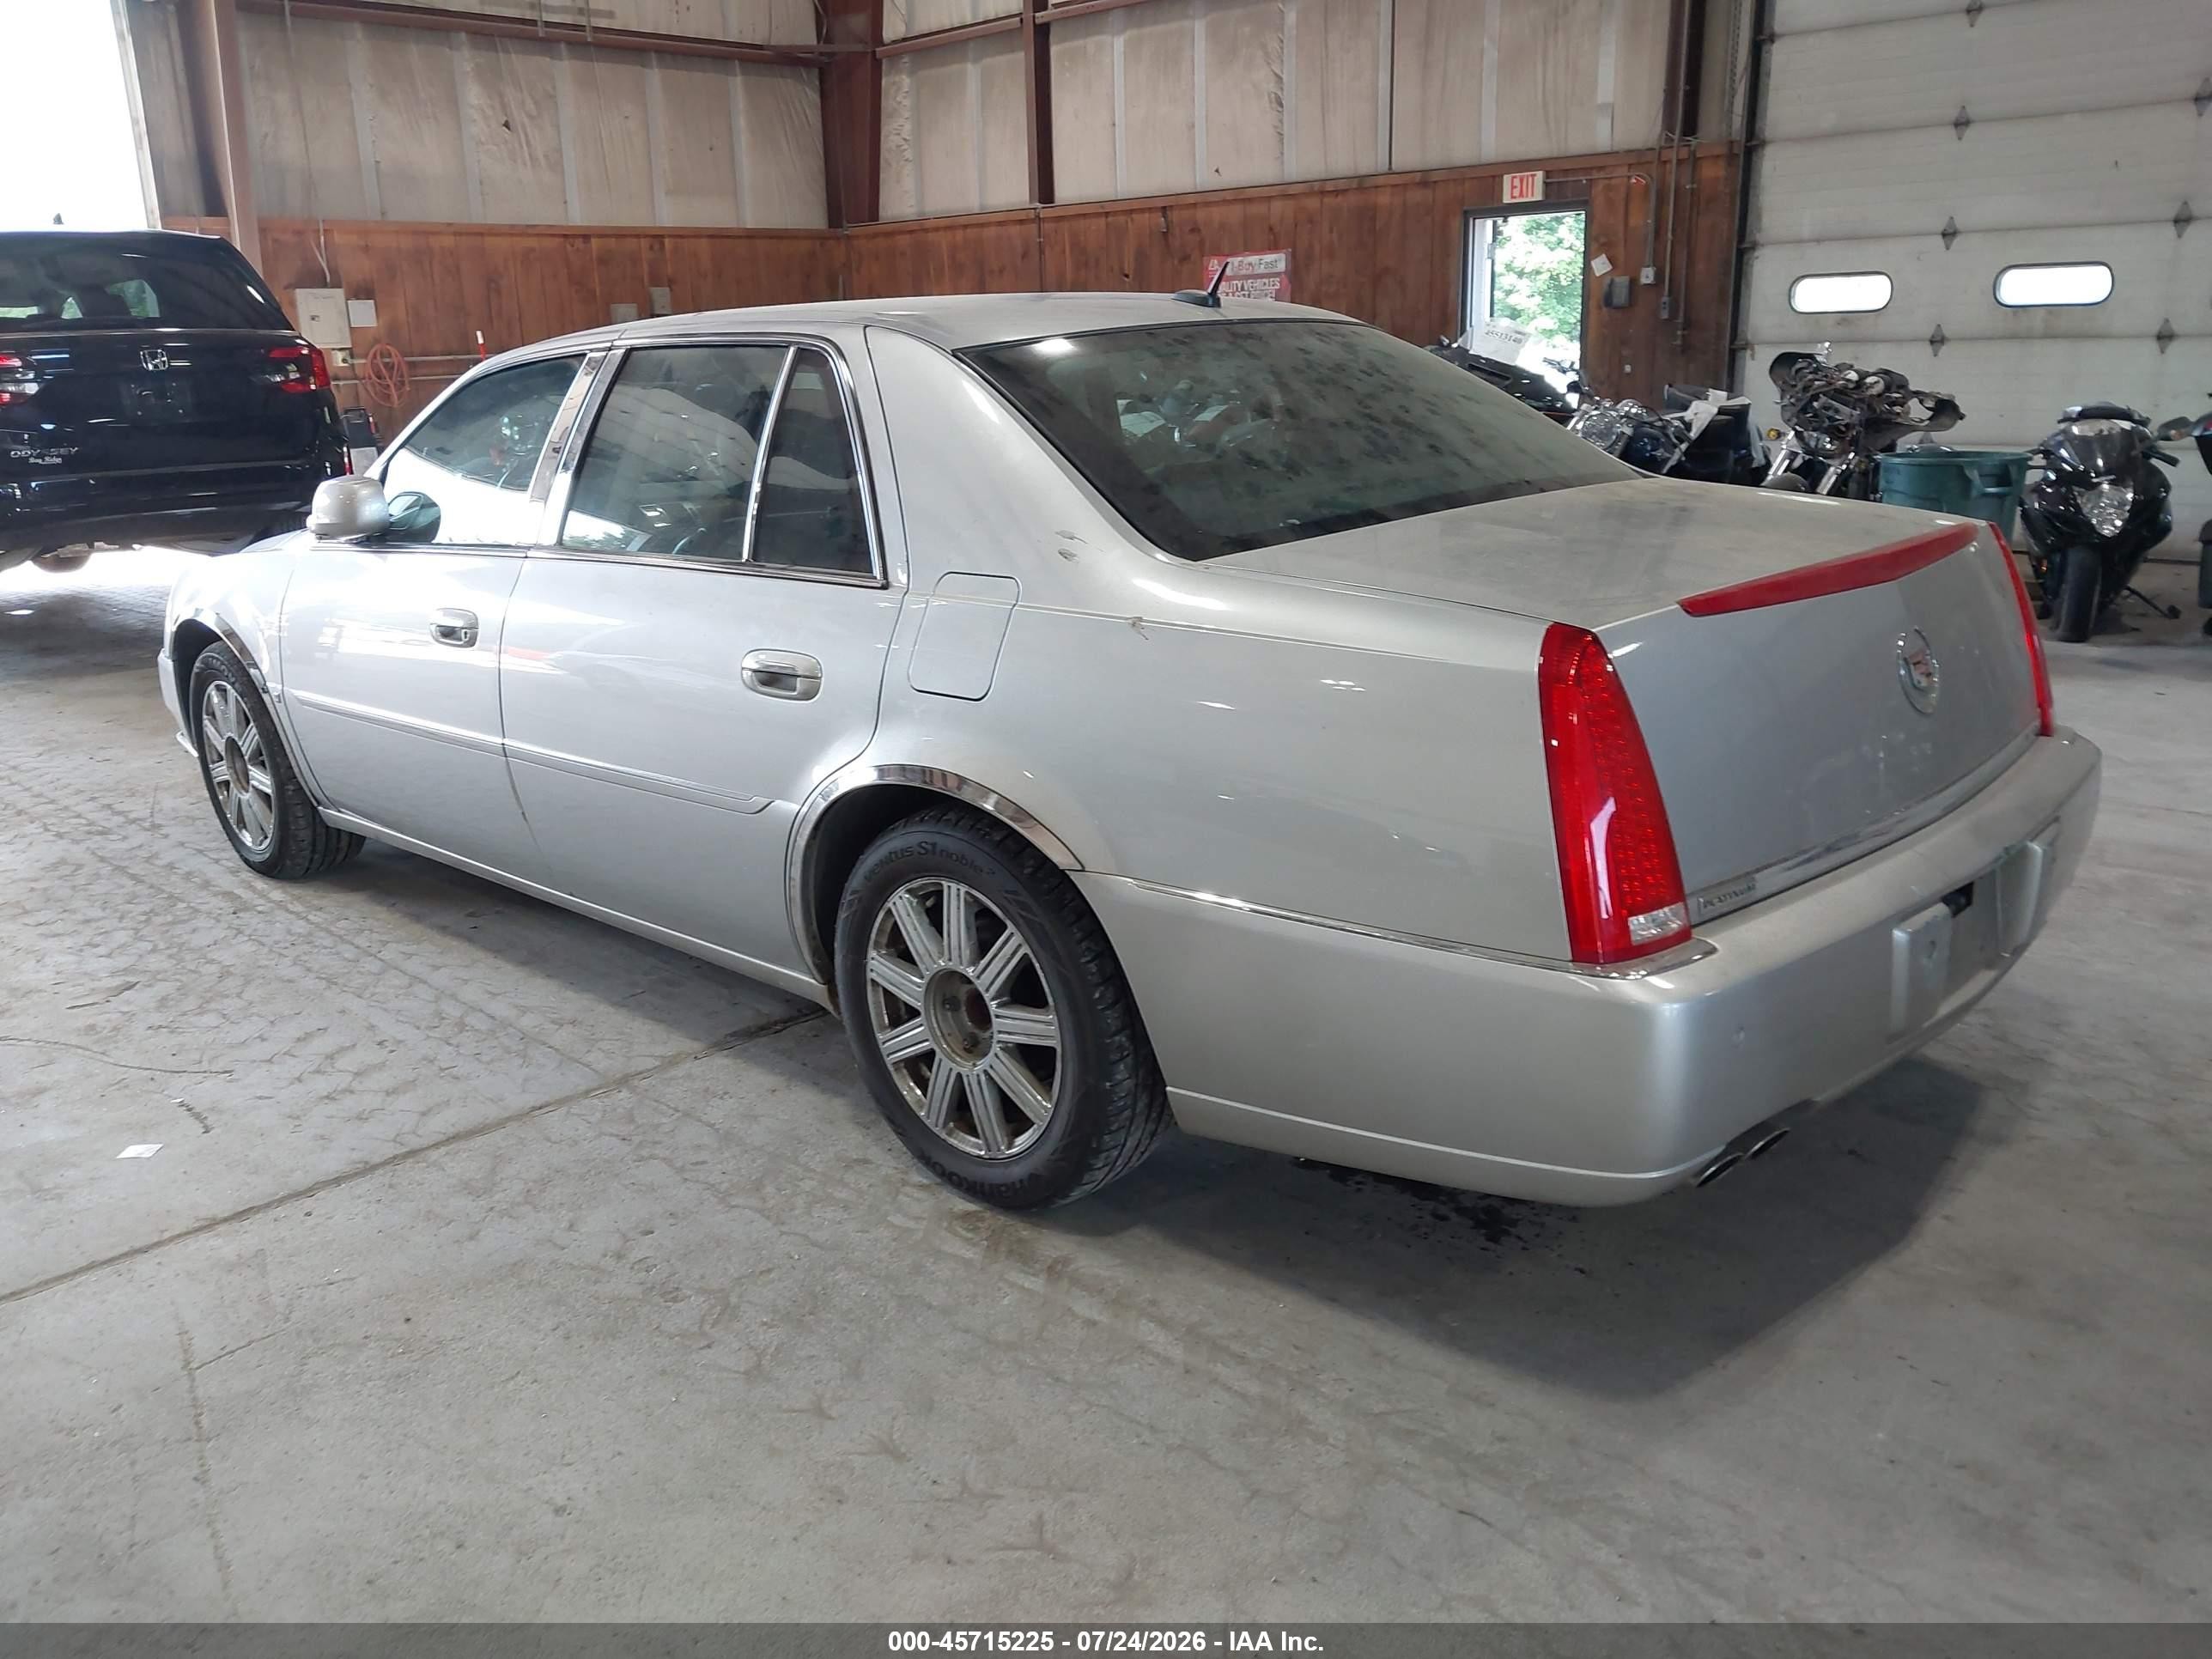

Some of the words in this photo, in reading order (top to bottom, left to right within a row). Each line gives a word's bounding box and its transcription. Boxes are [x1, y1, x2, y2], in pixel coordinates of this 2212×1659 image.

[1510, 173, 1537, 199] EXIT
[1258, 258, 1279, 270] Fast
[1242, 277, 1280, 290] VEHICLES
